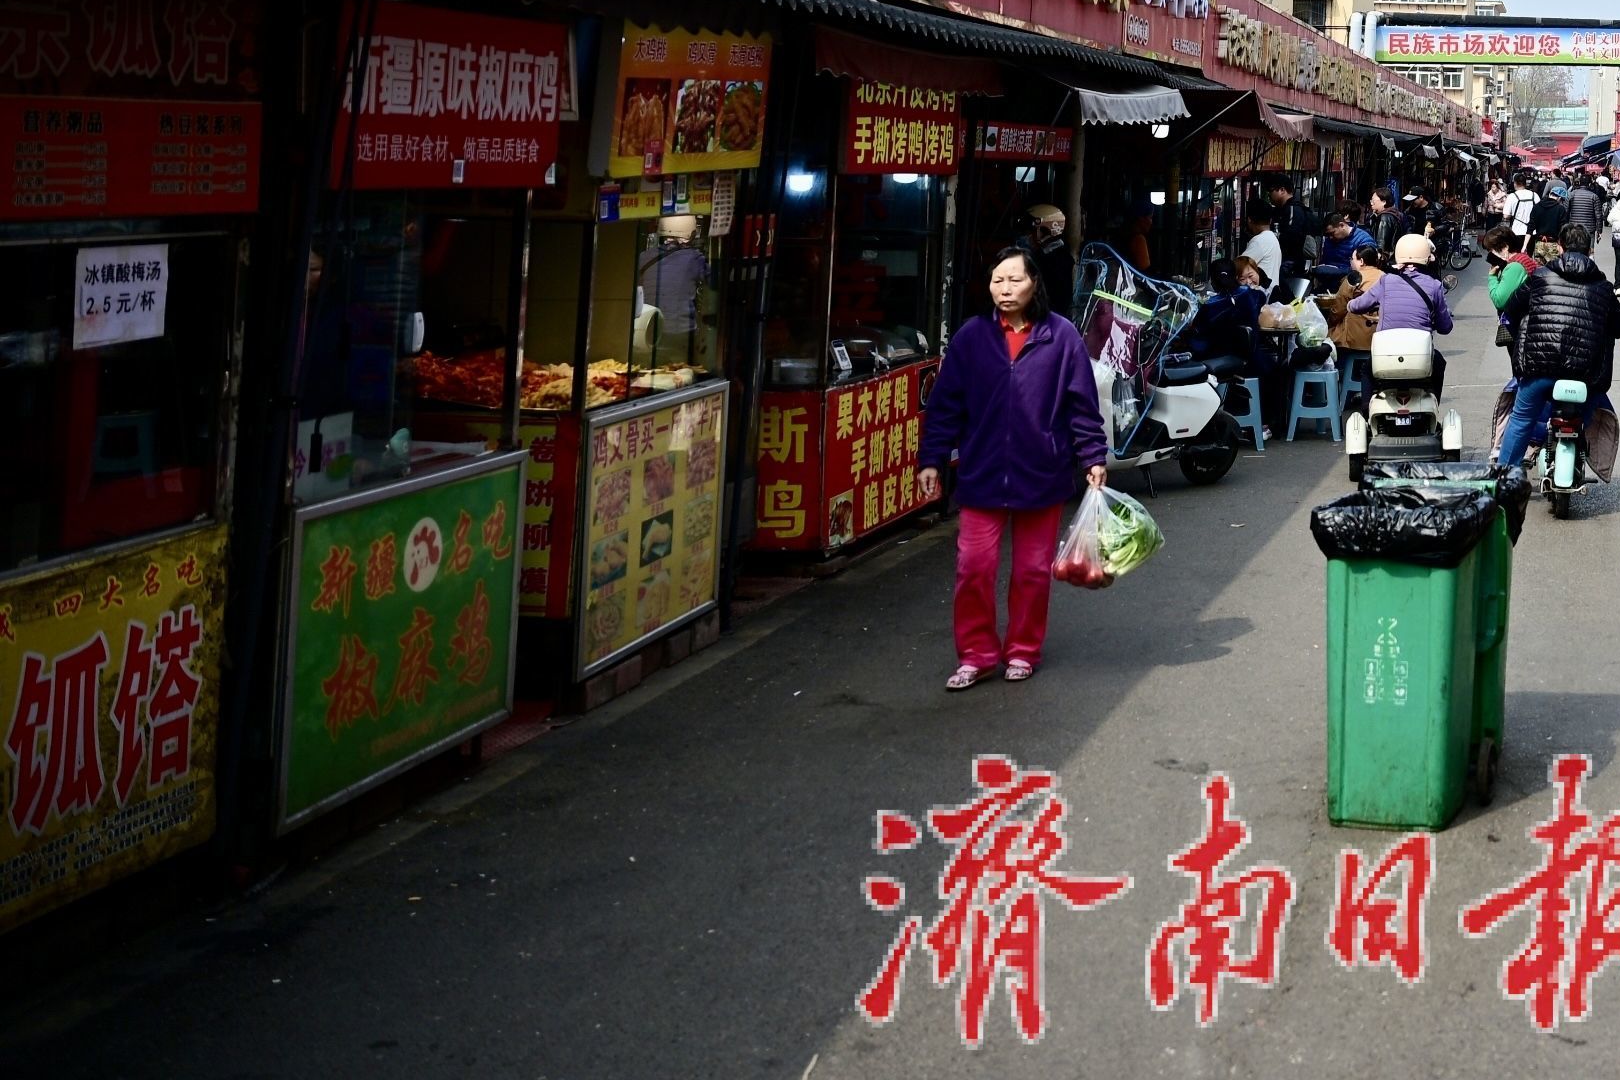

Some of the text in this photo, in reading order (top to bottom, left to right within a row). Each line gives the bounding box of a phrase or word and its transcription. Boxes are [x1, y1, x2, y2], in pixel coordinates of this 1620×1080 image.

[1388, 32, 1561, 57] 民族市场欢迎您
[342, 34, 559, 121] 新疆源味椒麻鸡
[854, 116, 954, 165] 手撕烤鸭烤鸡
[84, 261, 161, 284] 冰镇酸梅汤
[837, 371, 909, 440] 果木烤鸭
[863, 465, 926, 530] 脆皮烤
